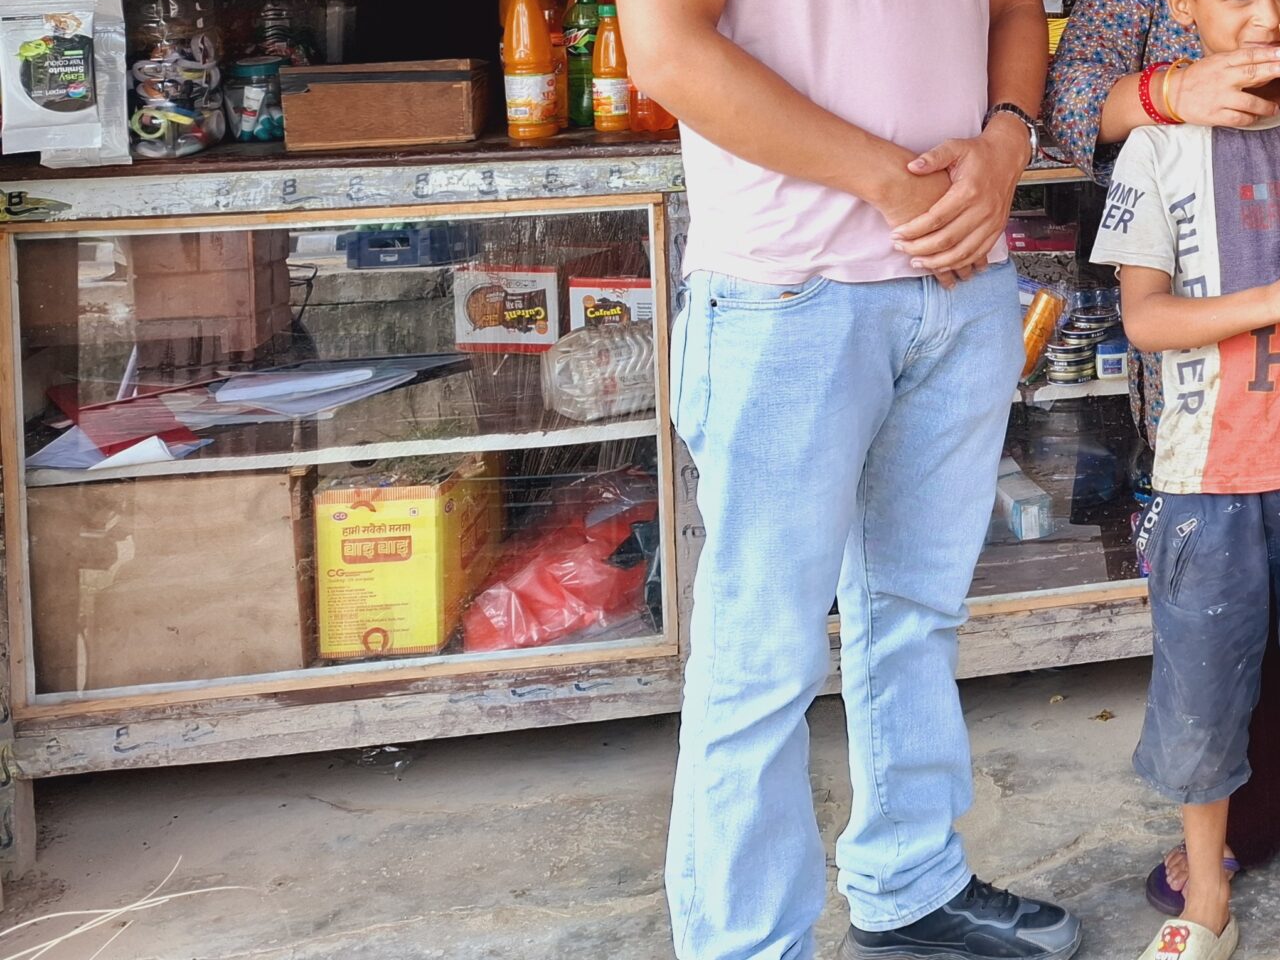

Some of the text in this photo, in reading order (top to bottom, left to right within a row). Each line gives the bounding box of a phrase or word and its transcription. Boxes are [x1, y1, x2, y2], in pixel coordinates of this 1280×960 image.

[48, 65, 85, 74] 5minute
[59, 72, 86, 82] Easy
[1107, 179, 1145, 209] MMY
[1101, 203, 1135, 234] ER
[1169, 192, 1208, 416] HILFER
[1137, 497, 1163, 553] argo
